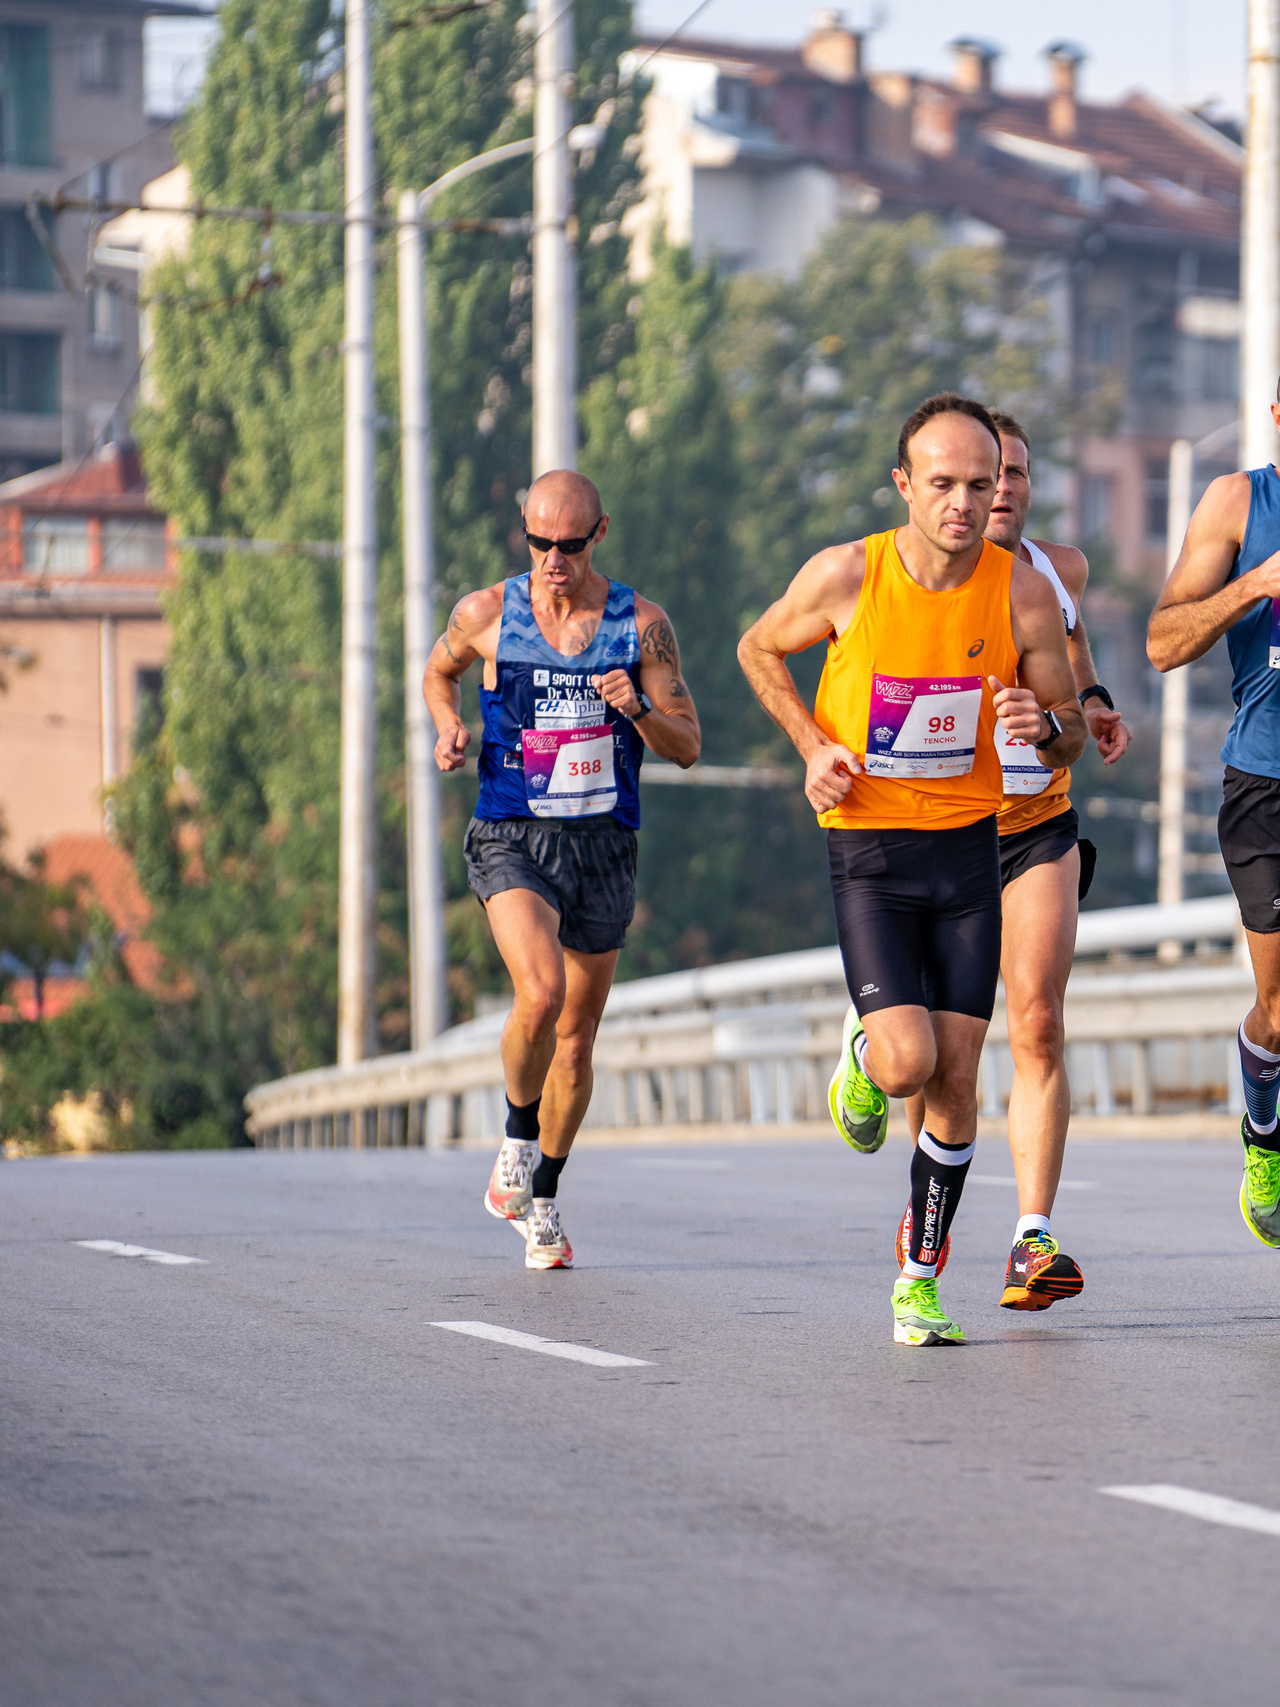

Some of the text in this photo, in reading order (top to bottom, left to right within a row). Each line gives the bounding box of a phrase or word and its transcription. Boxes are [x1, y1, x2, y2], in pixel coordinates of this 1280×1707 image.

[547, 687, 562, 700] Dr
[928, 715, 955, 733] 98
[923, 736, 957, 744] TENCHO
[877, 749, 892, 757] WIZZ
[568, 759, 602, 776] 388
